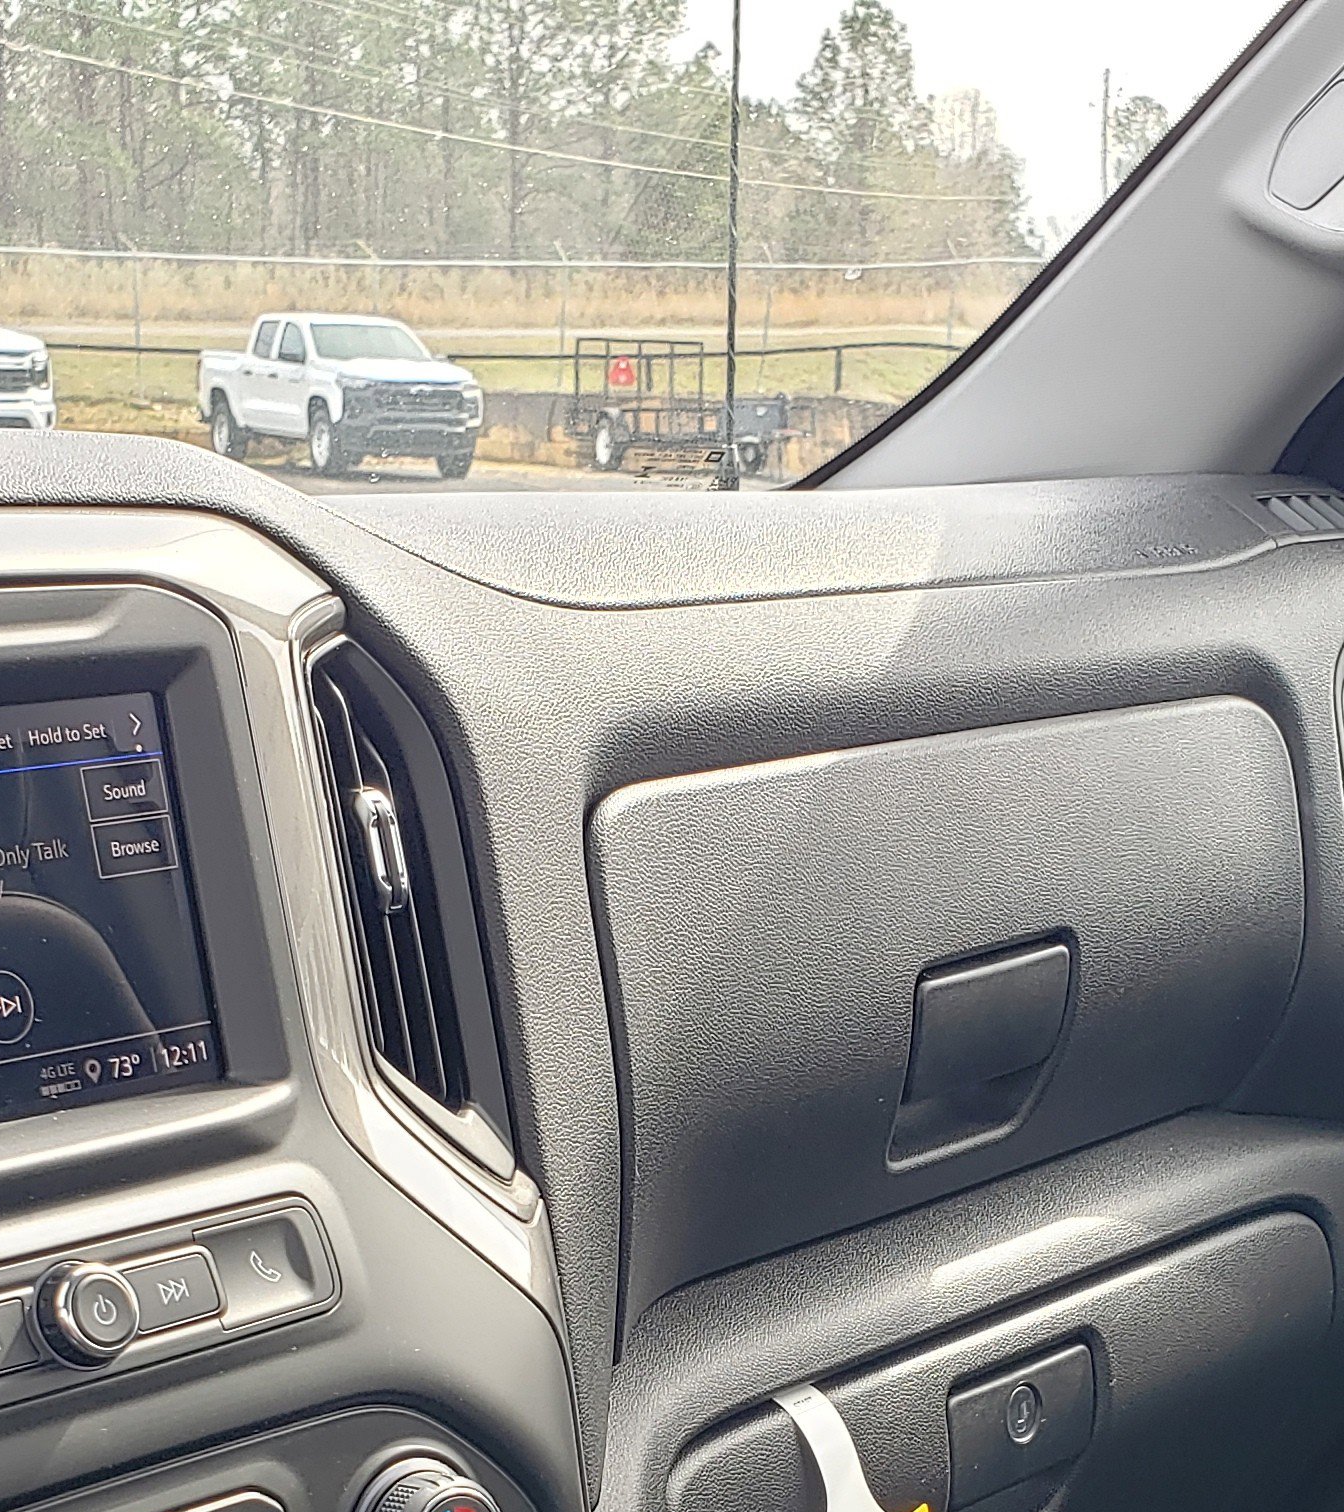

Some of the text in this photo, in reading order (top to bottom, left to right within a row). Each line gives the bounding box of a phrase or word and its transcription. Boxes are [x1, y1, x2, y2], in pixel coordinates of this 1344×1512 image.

[28, 723, 107, 747] Hold to Set
[104, 780, 146, 801] Sound
[32, 839, 69, 860] Talk
[111, 838, 160, 858] Browse
[161, 1040, 208, 1068] 12:11
[40, 1062, 77, 1080] 4G LTE
